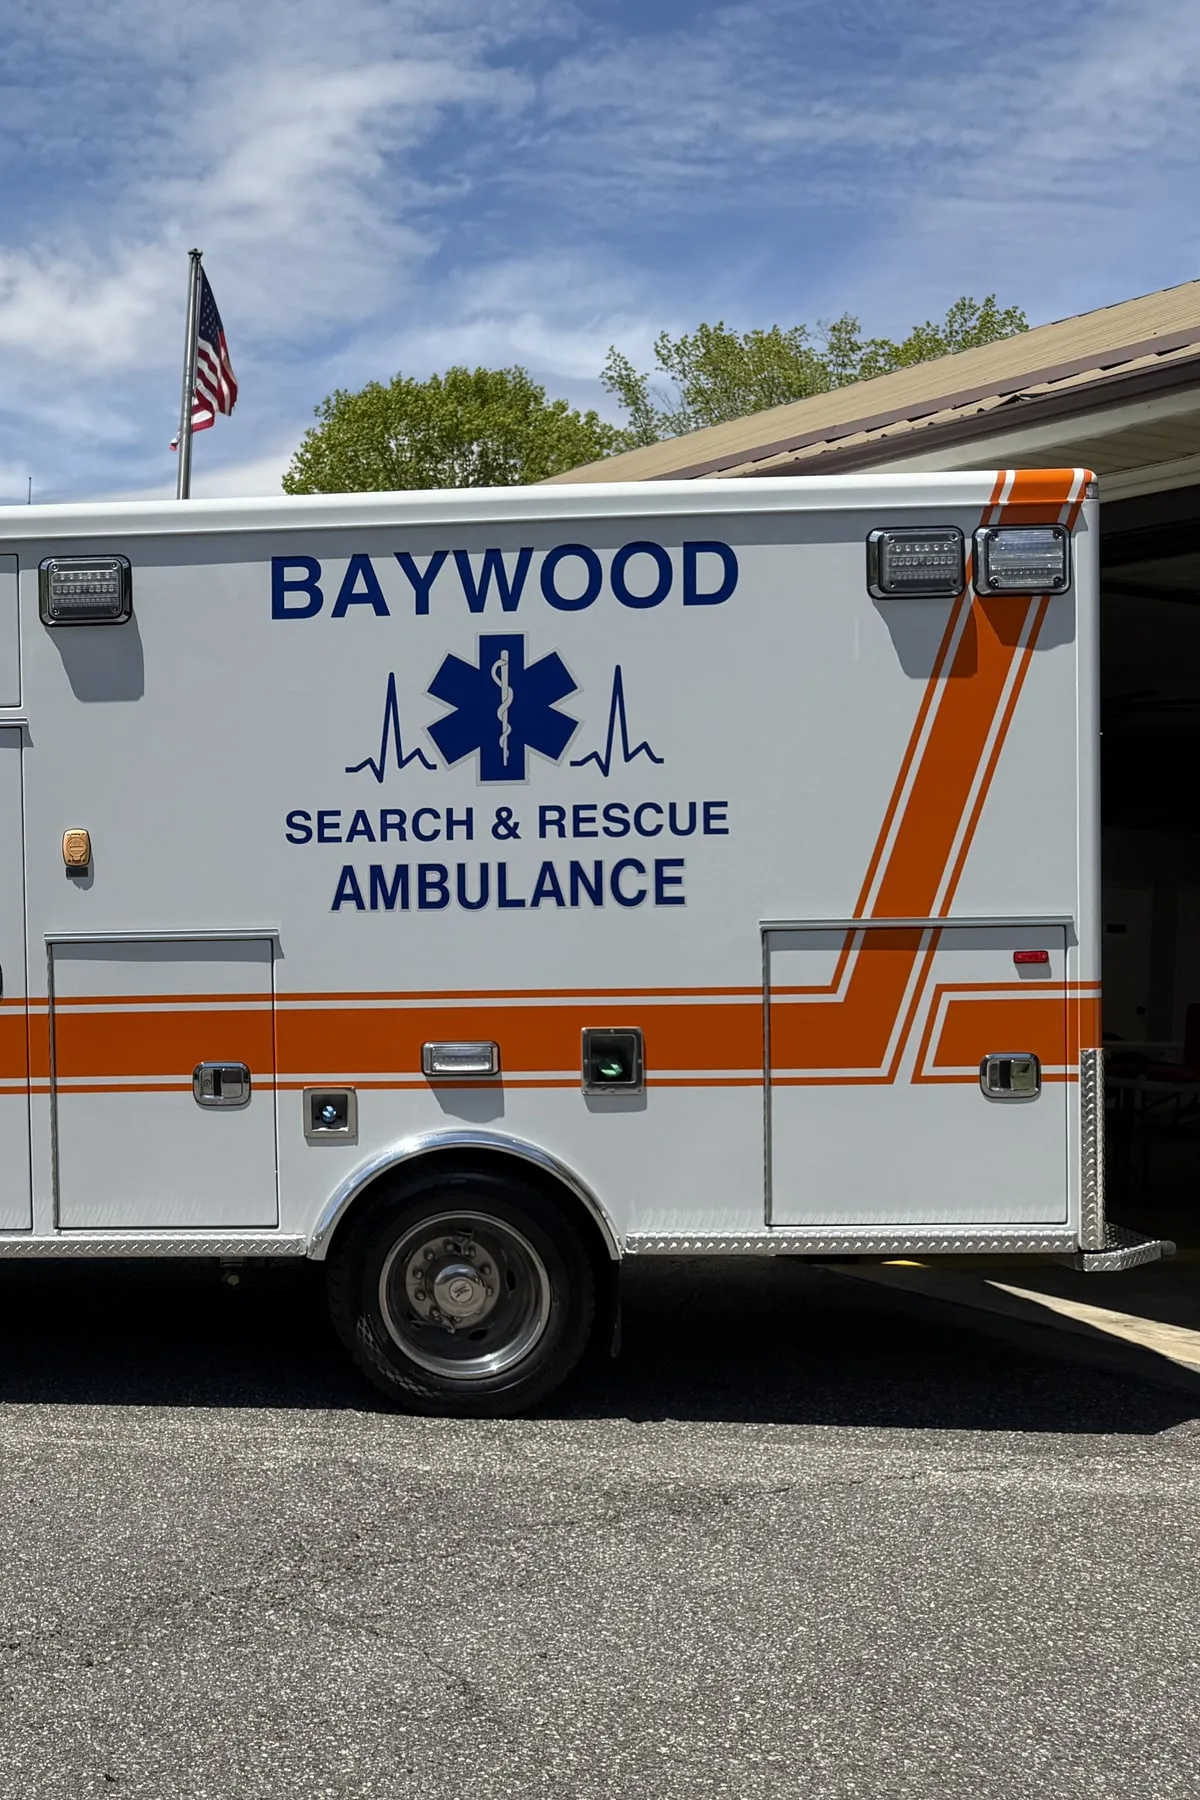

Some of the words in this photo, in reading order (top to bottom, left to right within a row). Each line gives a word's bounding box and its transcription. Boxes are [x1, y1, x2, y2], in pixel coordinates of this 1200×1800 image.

[271, 541, 739, 620] BAYWOOD
[286, 808, 474, 845] SEARCH
[492, 806, 521, 840] &
[538, 801, 729, 838] RESCUE
[331, 858, 686, 911] AMBULANCE
